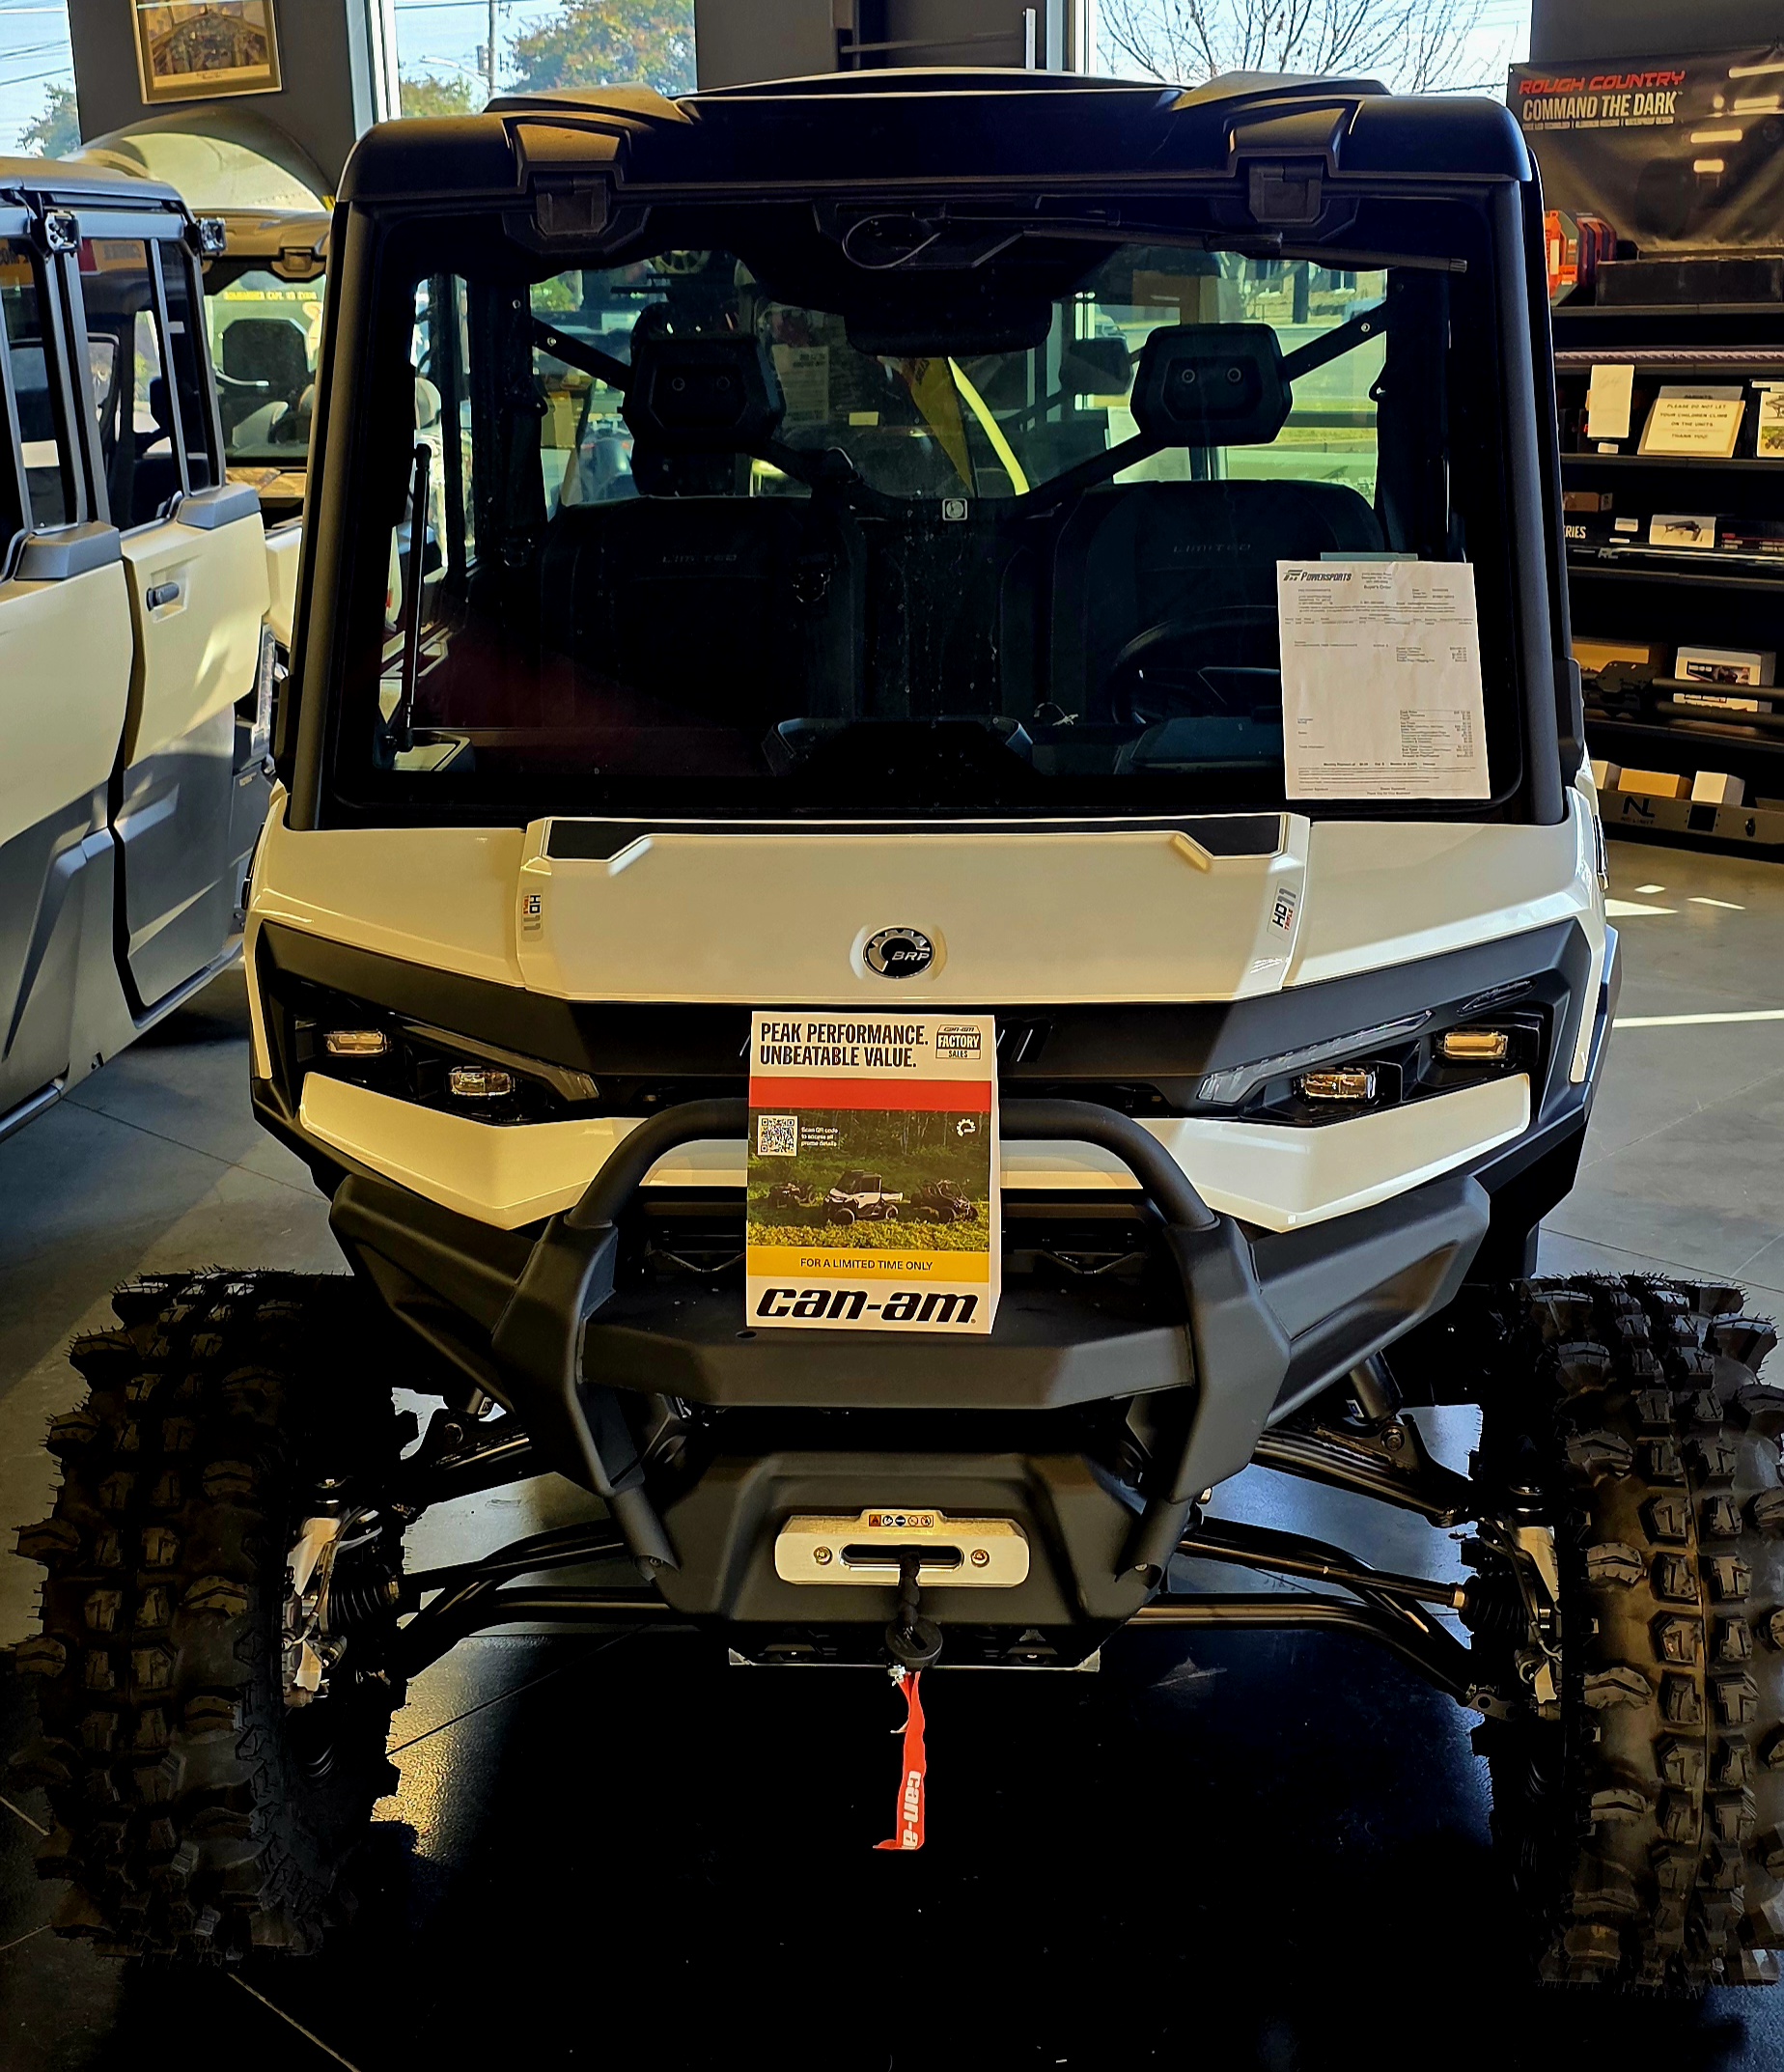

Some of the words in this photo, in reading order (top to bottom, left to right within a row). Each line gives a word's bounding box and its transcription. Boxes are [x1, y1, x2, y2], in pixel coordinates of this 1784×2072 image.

[1519, 77, 1586, 95] ROUGH
[1589, 70, 1686, 91] COUNTRY
[1522, 96, 1599, 121] COMMAND
[1602, 95, 1631, 118] THE
[1633, 91, 1678, 116] DARK
[1564, 525, 1586, 539] RIES
[891, 951, 930, 962] BRP
[761, 1022, 802, 1043] PEAK
[806, 1023, 929, 1046] PERFORMANCE.
[937, 1034, 980, 1049] FACTORY
[760, 1045, 860, 1067] UNBEATABLE
[864, 1047, 917, 1068] VALUE.
[948, 1050, 968, 1058] SALES
[800, 1258, 822, 1268] FOR
[822, 1258, 831, 1268] A
[833, 1259, 876, 1269] LIMITED
[878, 1260, 904, 1270] TIME
[906, 1260, 934, 1271] ONLY
[903, 1770, 921, 1849] can-a
